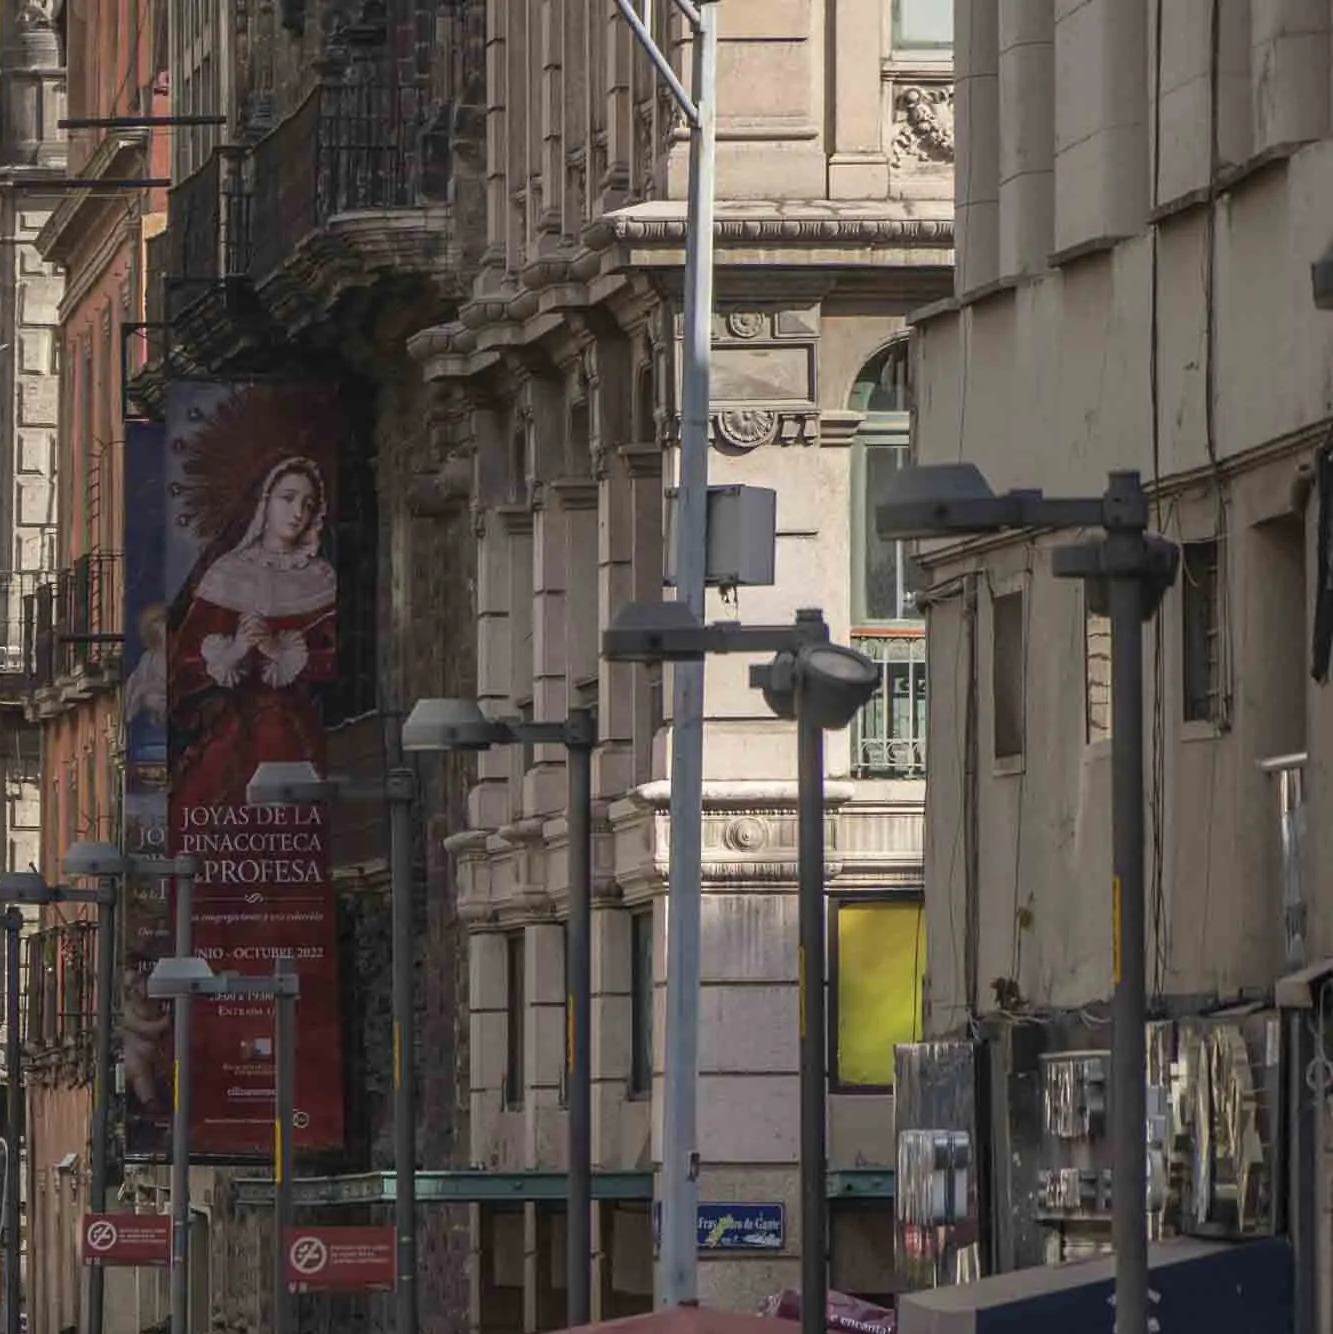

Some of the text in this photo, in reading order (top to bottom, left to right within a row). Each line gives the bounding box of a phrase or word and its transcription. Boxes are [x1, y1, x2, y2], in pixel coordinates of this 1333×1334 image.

[180, 806, 323, 831] JOYAS DE LA
[180, 833, 322, 853] PINACOTECA
[204, 861, 324, 884] PROFESA
[196, 948, 224, 959] NIO
